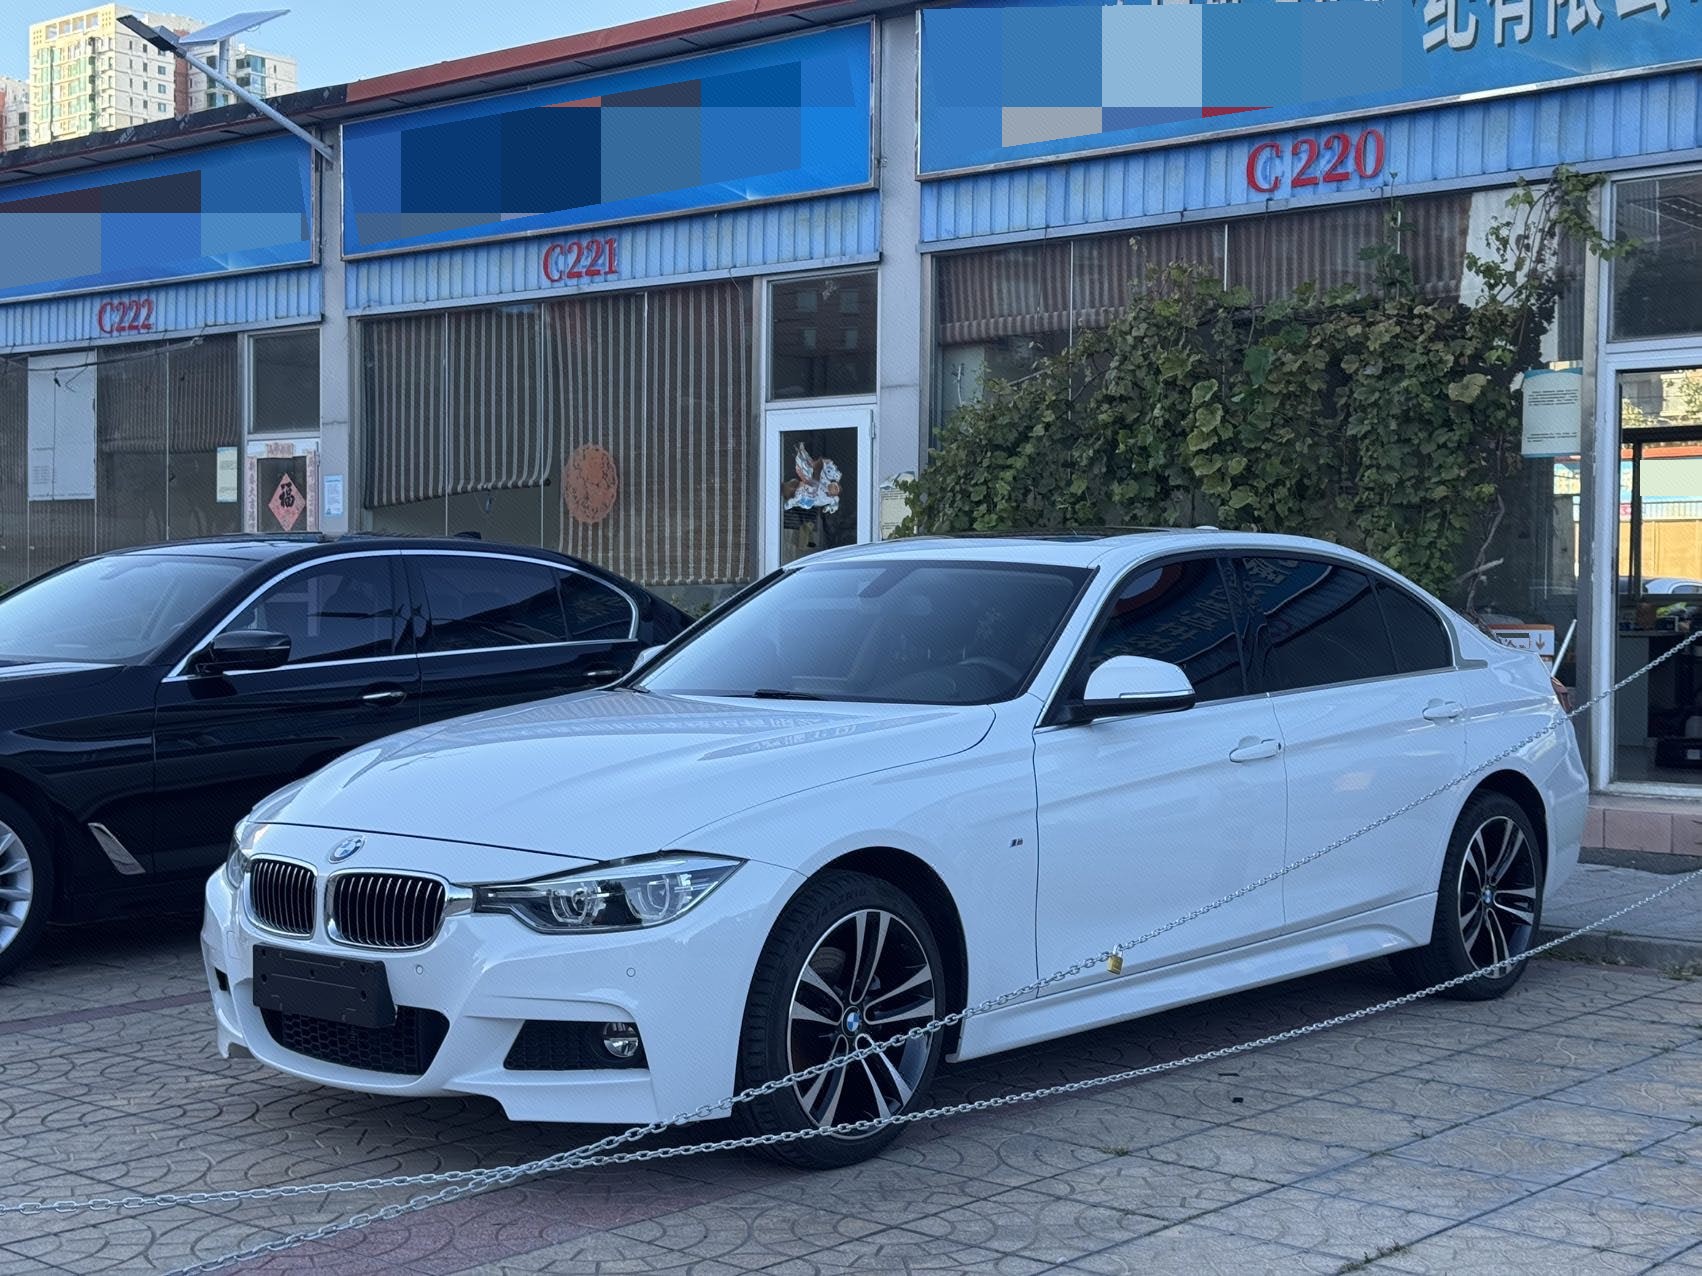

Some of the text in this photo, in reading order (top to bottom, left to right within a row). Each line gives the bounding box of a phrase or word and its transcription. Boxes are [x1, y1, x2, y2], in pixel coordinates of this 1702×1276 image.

[1246, 128, 1385, 193] C220
[542, 237, 619, 282] C221
[98, 298, 154, 334] C222
[279, 482, 295, 508] 福
